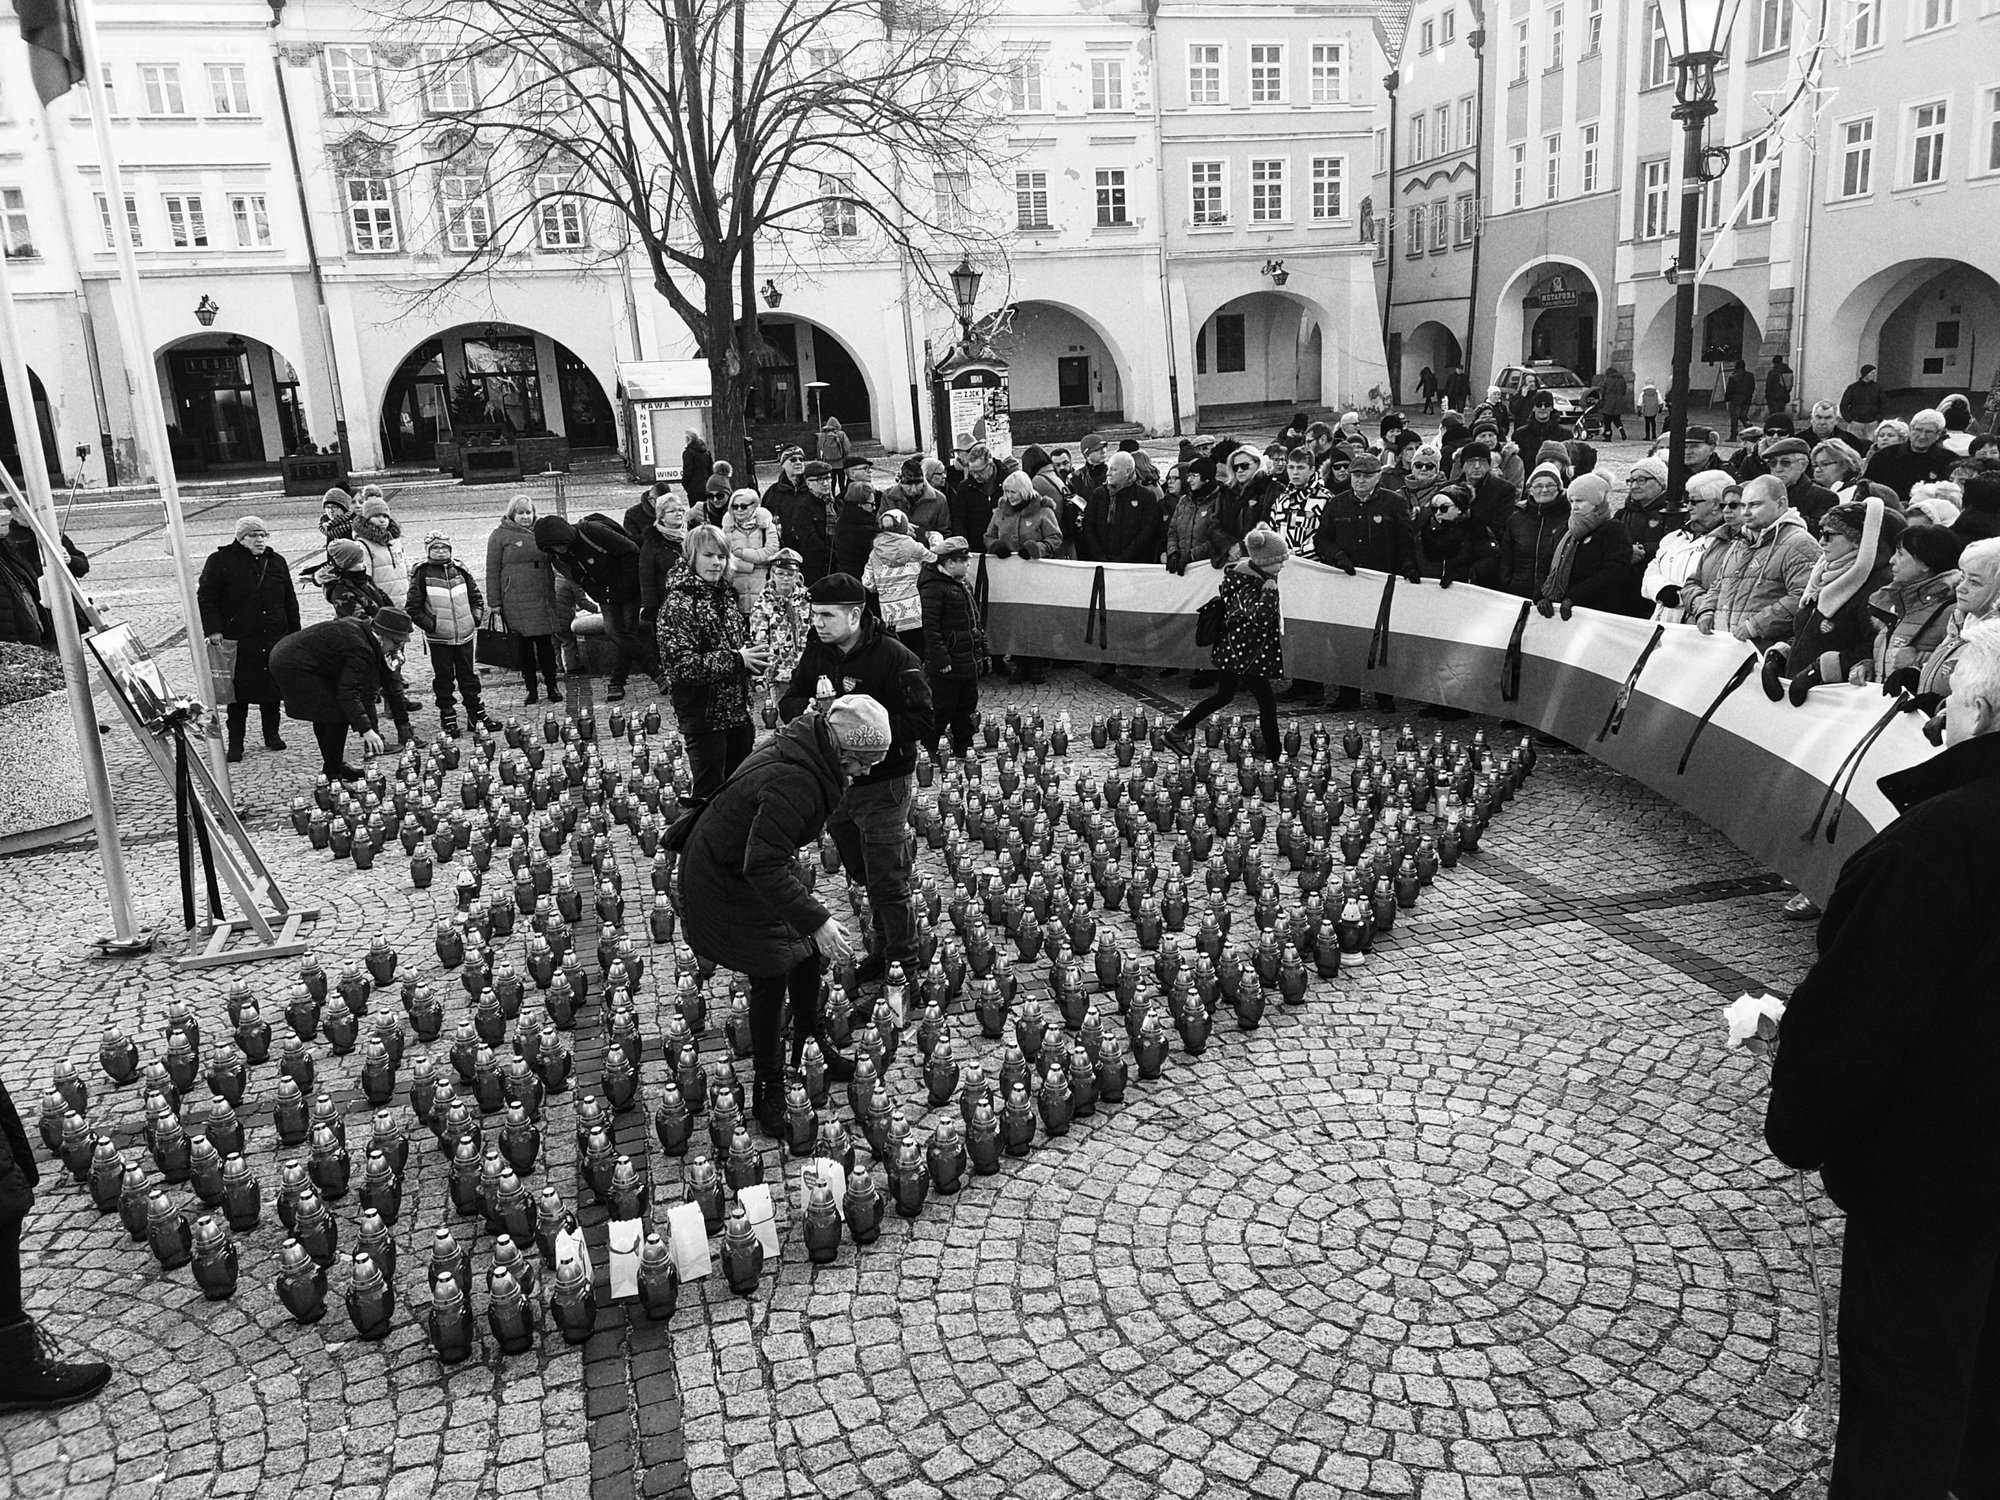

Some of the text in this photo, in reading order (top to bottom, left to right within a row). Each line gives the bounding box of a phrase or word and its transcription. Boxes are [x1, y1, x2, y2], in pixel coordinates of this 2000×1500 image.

[640, 399, 710, 411] KAWA PIWO
[640, 414, 650, 462] NAPOJE
[656, 470, 679, 478] WINO
